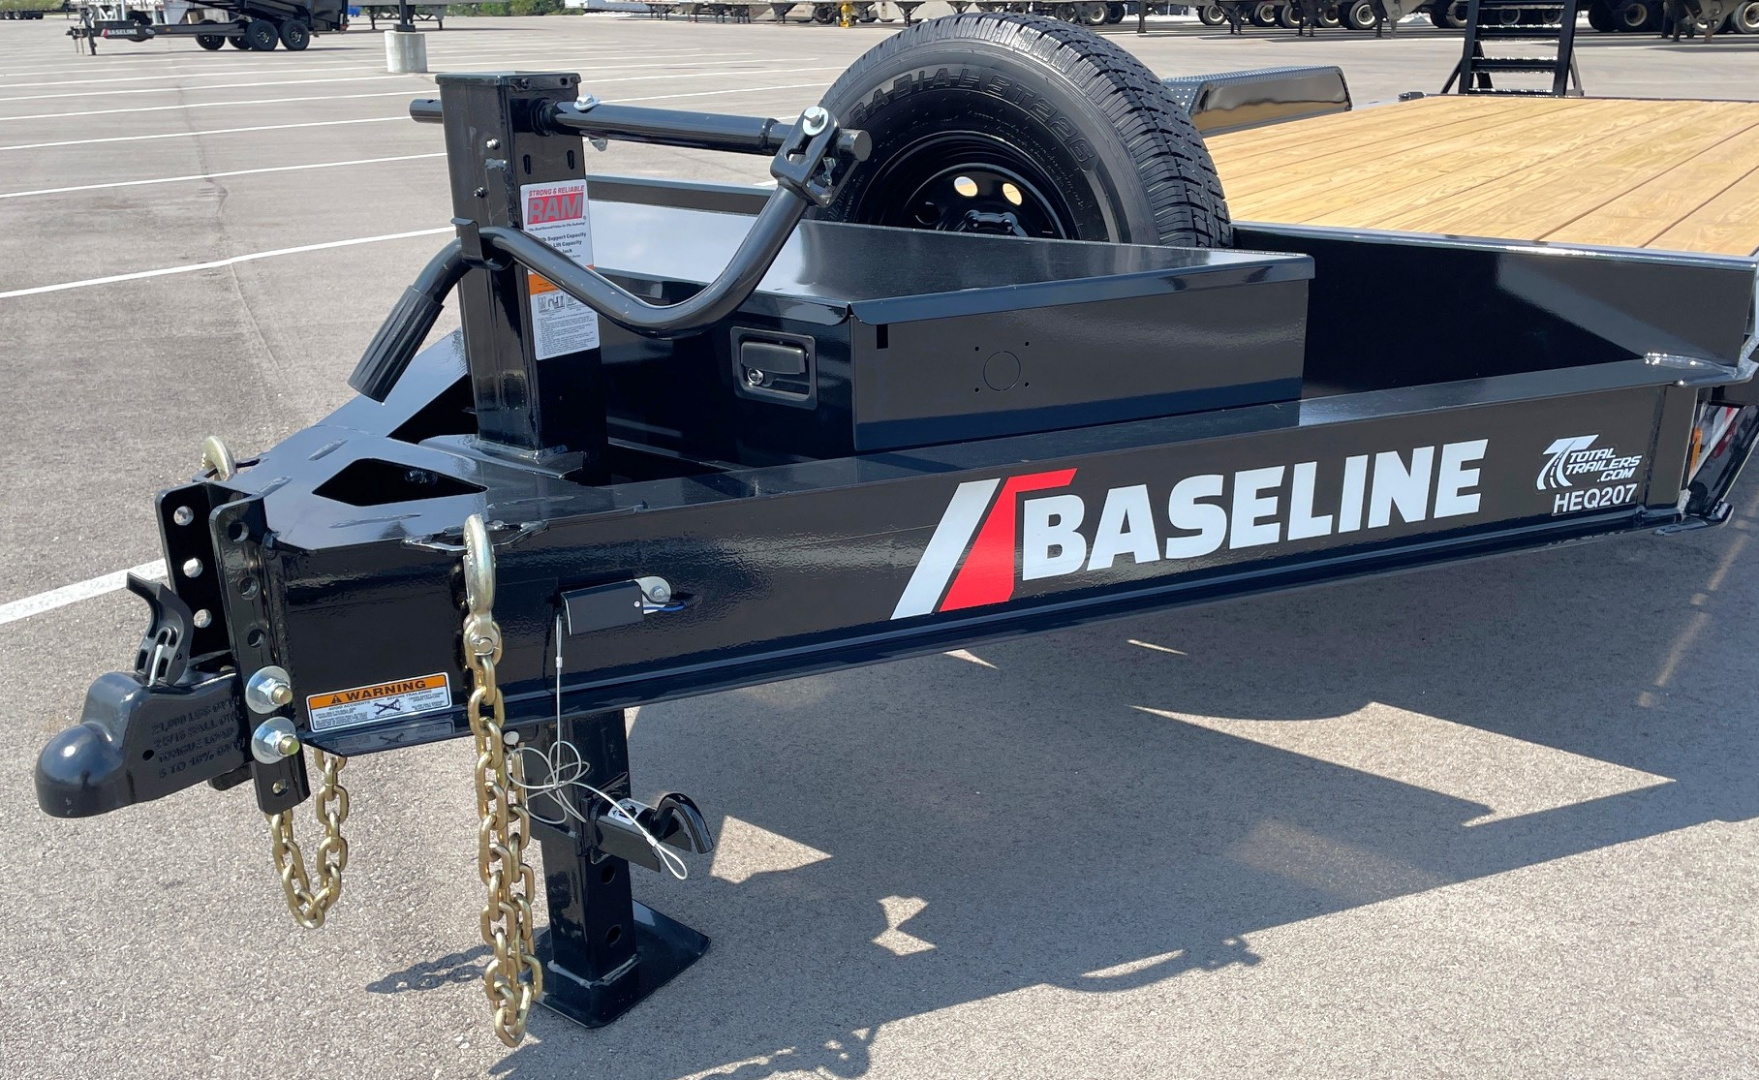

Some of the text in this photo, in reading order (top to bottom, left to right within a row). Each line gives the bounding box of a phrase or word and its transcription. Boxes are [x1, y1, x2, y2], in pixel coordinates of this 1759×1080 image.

[849, 68, 974, 124] RADIAL
[529, 188, 552, 197] STRONG
[558, 185, 584, 194] RELIABLE
[528, 194, 582, 224] RAM
[548, 234, 567, 242] Support
[1566, 455, 1642, 475] TRAILERS
[1569, 448, 1616, 463] TOTAL
[1597, 467, 1636, 482] .COM
[1553, 483, 1637, 513] HEQ207
[1022, 439, 1489, 581] BASELINE
[346, 681, 426, 701] WARNING
